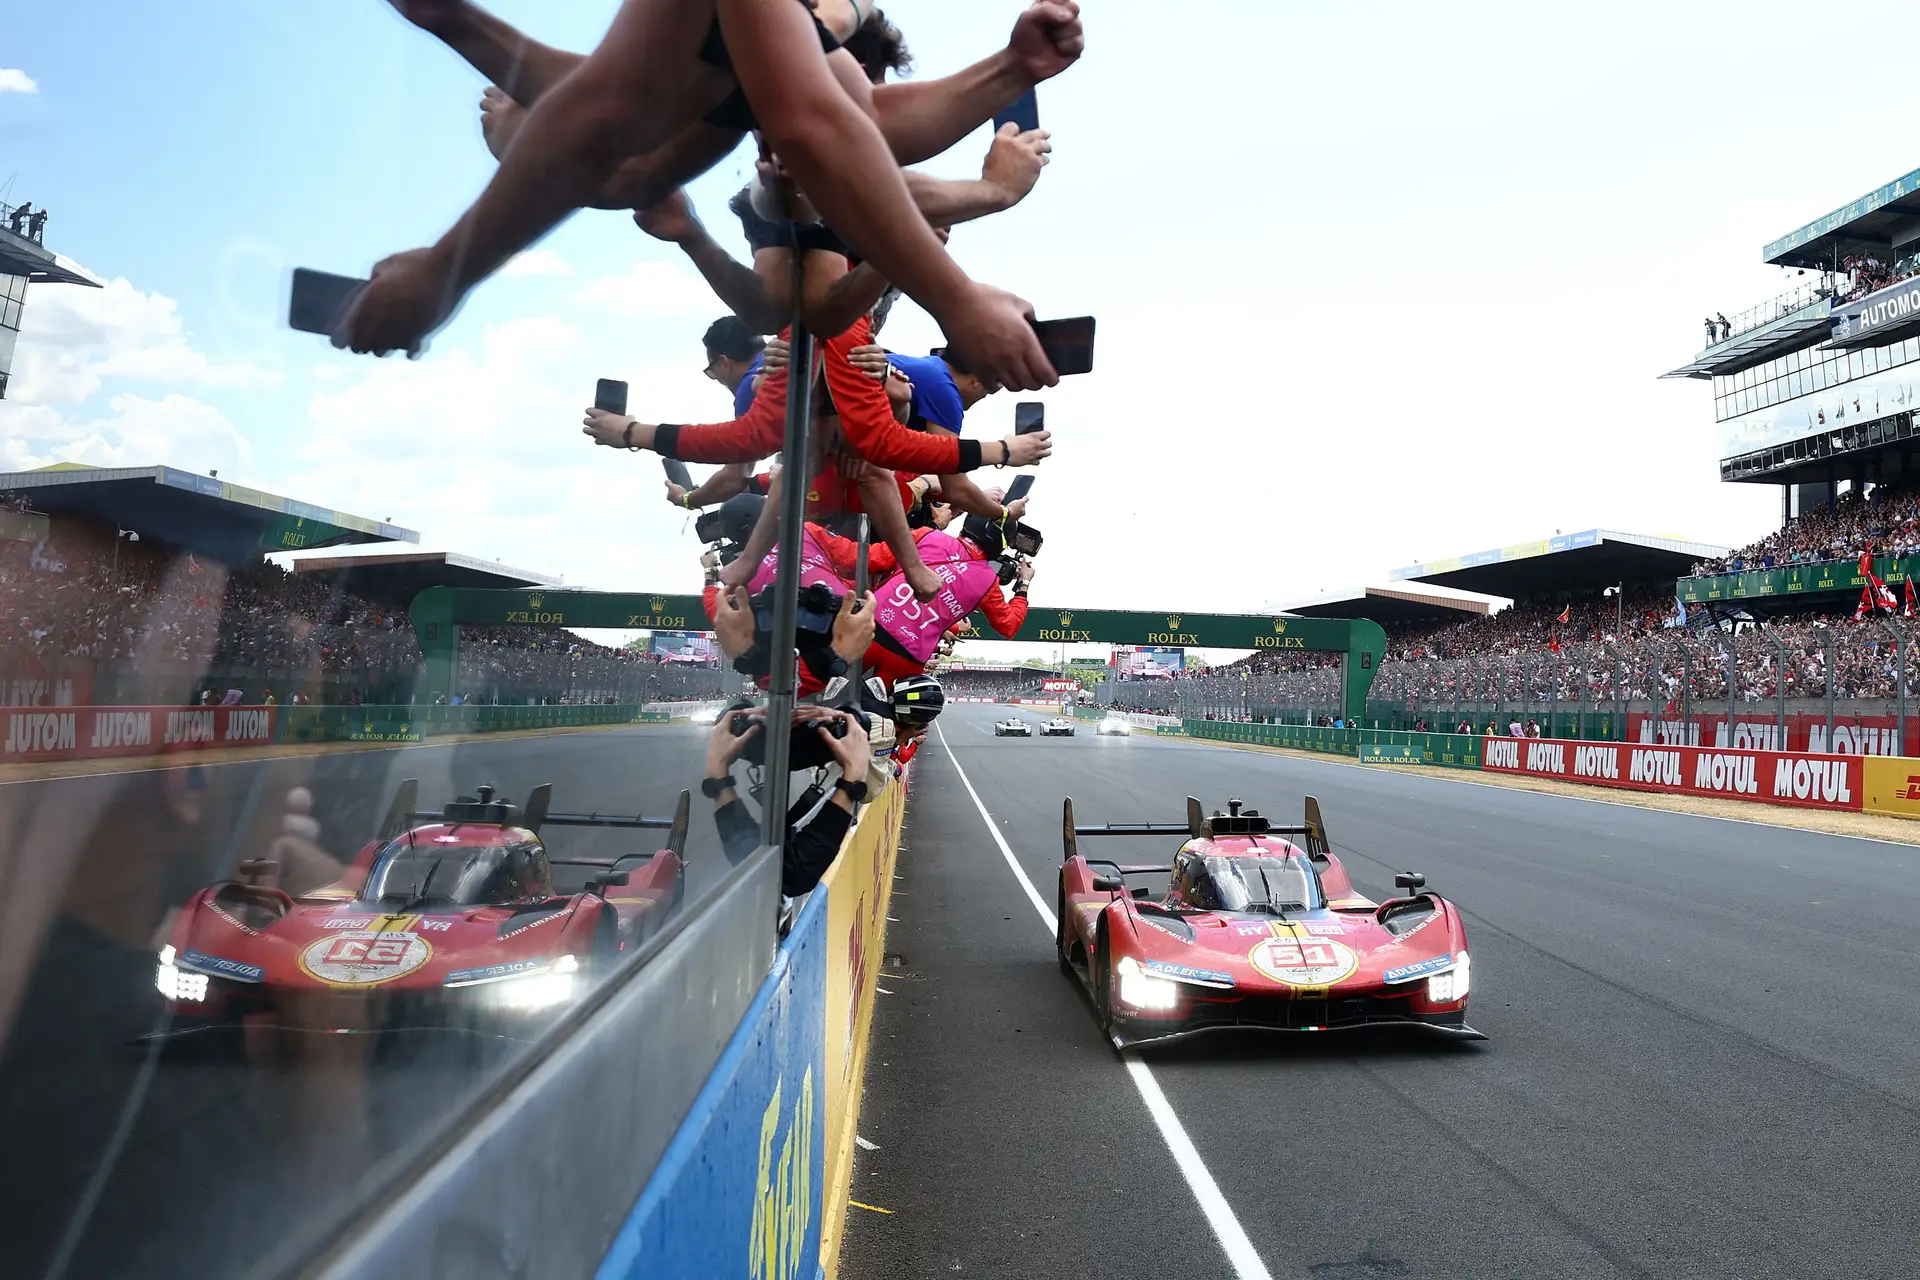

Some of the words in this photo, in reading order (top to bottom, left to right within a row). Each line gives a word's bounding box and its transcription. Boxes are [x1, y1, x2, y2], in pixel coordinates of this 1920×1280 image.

[1860, 289, 1920, 329] AUTOMO
[935, 564, 957, 584] ENG
[888, 583, 939, 630] 957
[940, 589, 964, 617] TRACK
[1039, 629, 1091, 641] ROLEX
[1148, 632, 1199, 645] ROLEX
[1254, 636, 1304, 648] ROLEX
[1044, 682, 1078, 691] MOTUL
[1363, 755, 1391, 763] ROLEX
[1393, 756, 1421, 764] ROLEX
[1486, 740, 1519, 768] MOTUL
[1527, 743, 1565, 773] MOTUL
[1574, 746, 1619, 779] MOTUL
[1629, 749, 1682, 786] MOTUL
[1695, 753, 1758, 793] MOTUL
[1773, 758, 1850, 803] MOTUL
[1427, 909, 1445, 925] MILLE
[1130, 913, 1166, 933] RICHARD
[1166, 931, 1195, 946] MILLE
[1237, 926, 1263, 936] HY
[1272, 946, 1334, 964] 51
[1155, 963, 1199, 978] ADLER
[1388, 963, 1425, 979] ADLER
